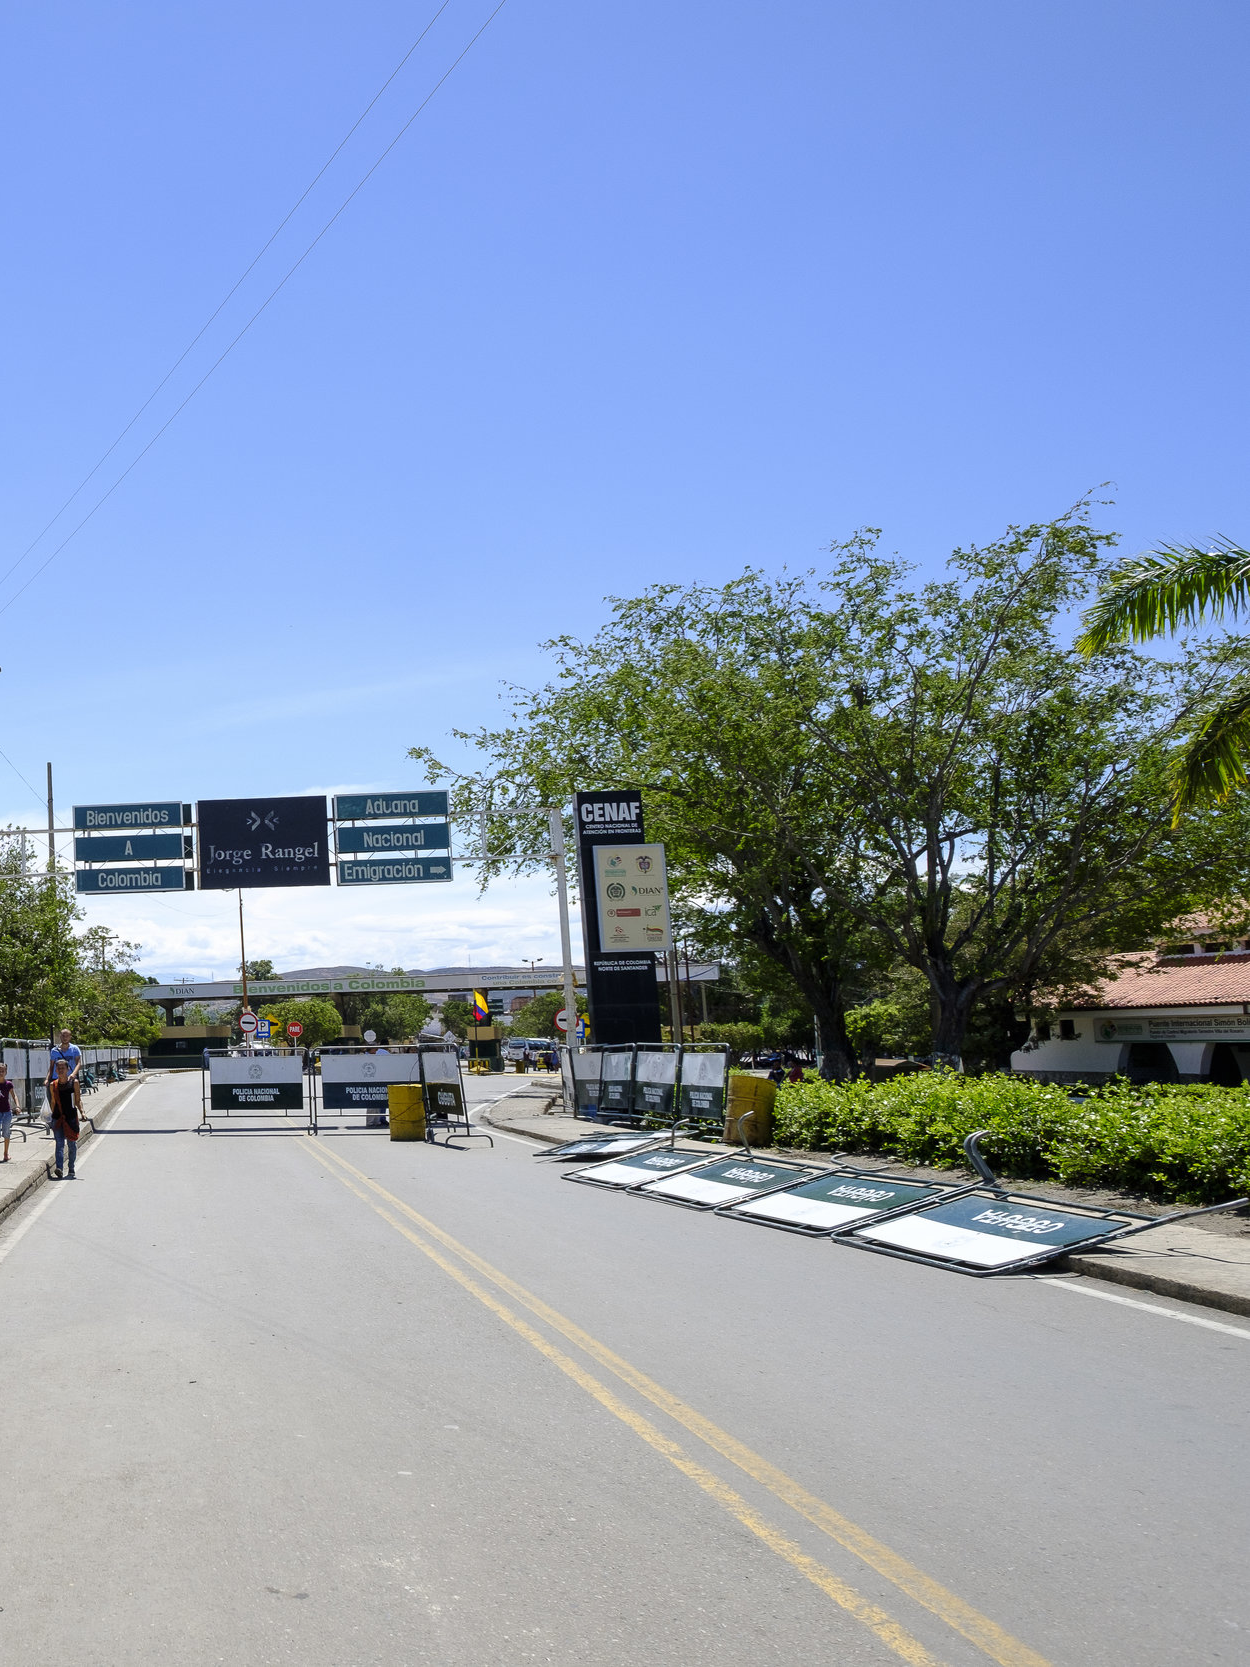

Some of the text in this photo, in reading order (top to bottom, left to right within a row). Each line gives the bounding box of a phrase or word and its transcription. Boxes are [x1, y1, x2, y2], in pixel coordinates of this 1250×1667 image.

[365, 798, 419, 814] Aduana
[581, 802, 640, 822] CENAF
[86, 808, 169, 826] Bienvenidos
[363, 830, 425, 848] Nacional
[124, 840, 133, 855] A
[207, 842, 318, 865] Jorge Rangel
[98, 871, 161, 887] Colombia
[344, 862, 423, 881] Emigración
[638, 887, 661, 895] DIAN
[481, 973, 519, 981] Contribuir
[232, 979, 426, 994] Benvenidos a Colombia
[254, 1087, 280, 1095] NACIONAL
